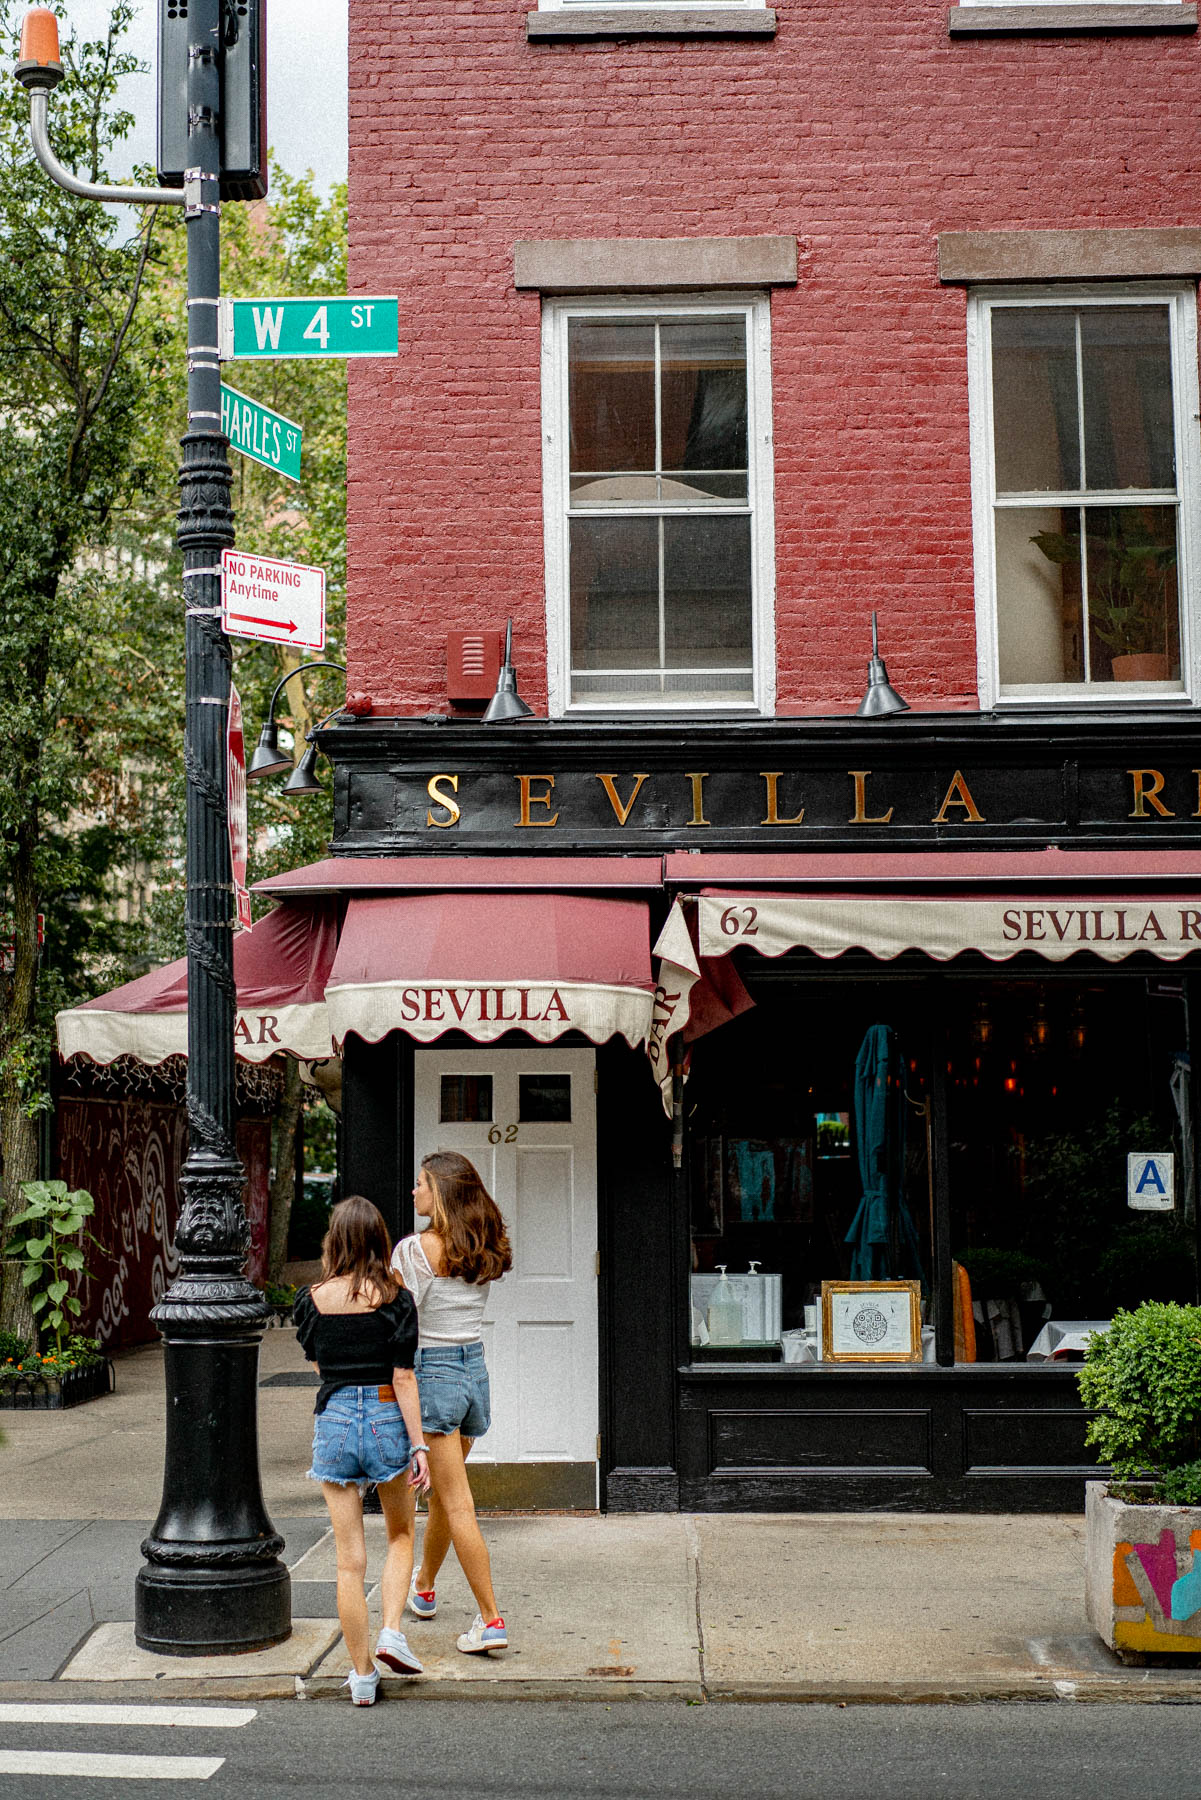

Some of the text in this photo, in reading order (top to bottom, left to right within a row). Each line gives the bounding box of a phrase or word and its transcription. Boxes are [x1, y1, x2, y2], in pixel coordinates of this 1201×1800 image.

[252, 305, 375, 350] W 4 ST
[220, 391, 298, 464] HARLES ST
[229, 560, 301, 588] NO PARKING
[229, 579, 279, 602] Anytime
[427, 769, 1201, 828] SEVILLA R
[719, 906, 759, 936] 62
[1002, 909, 1168, 942] SEVILLA
[401, 988, 571, 1022] SEVILLA
[234, 1015, 282, 1045] AR
[487, 1124, 519, 1145] 62
[1135, 1159, 1166, 1194] A
